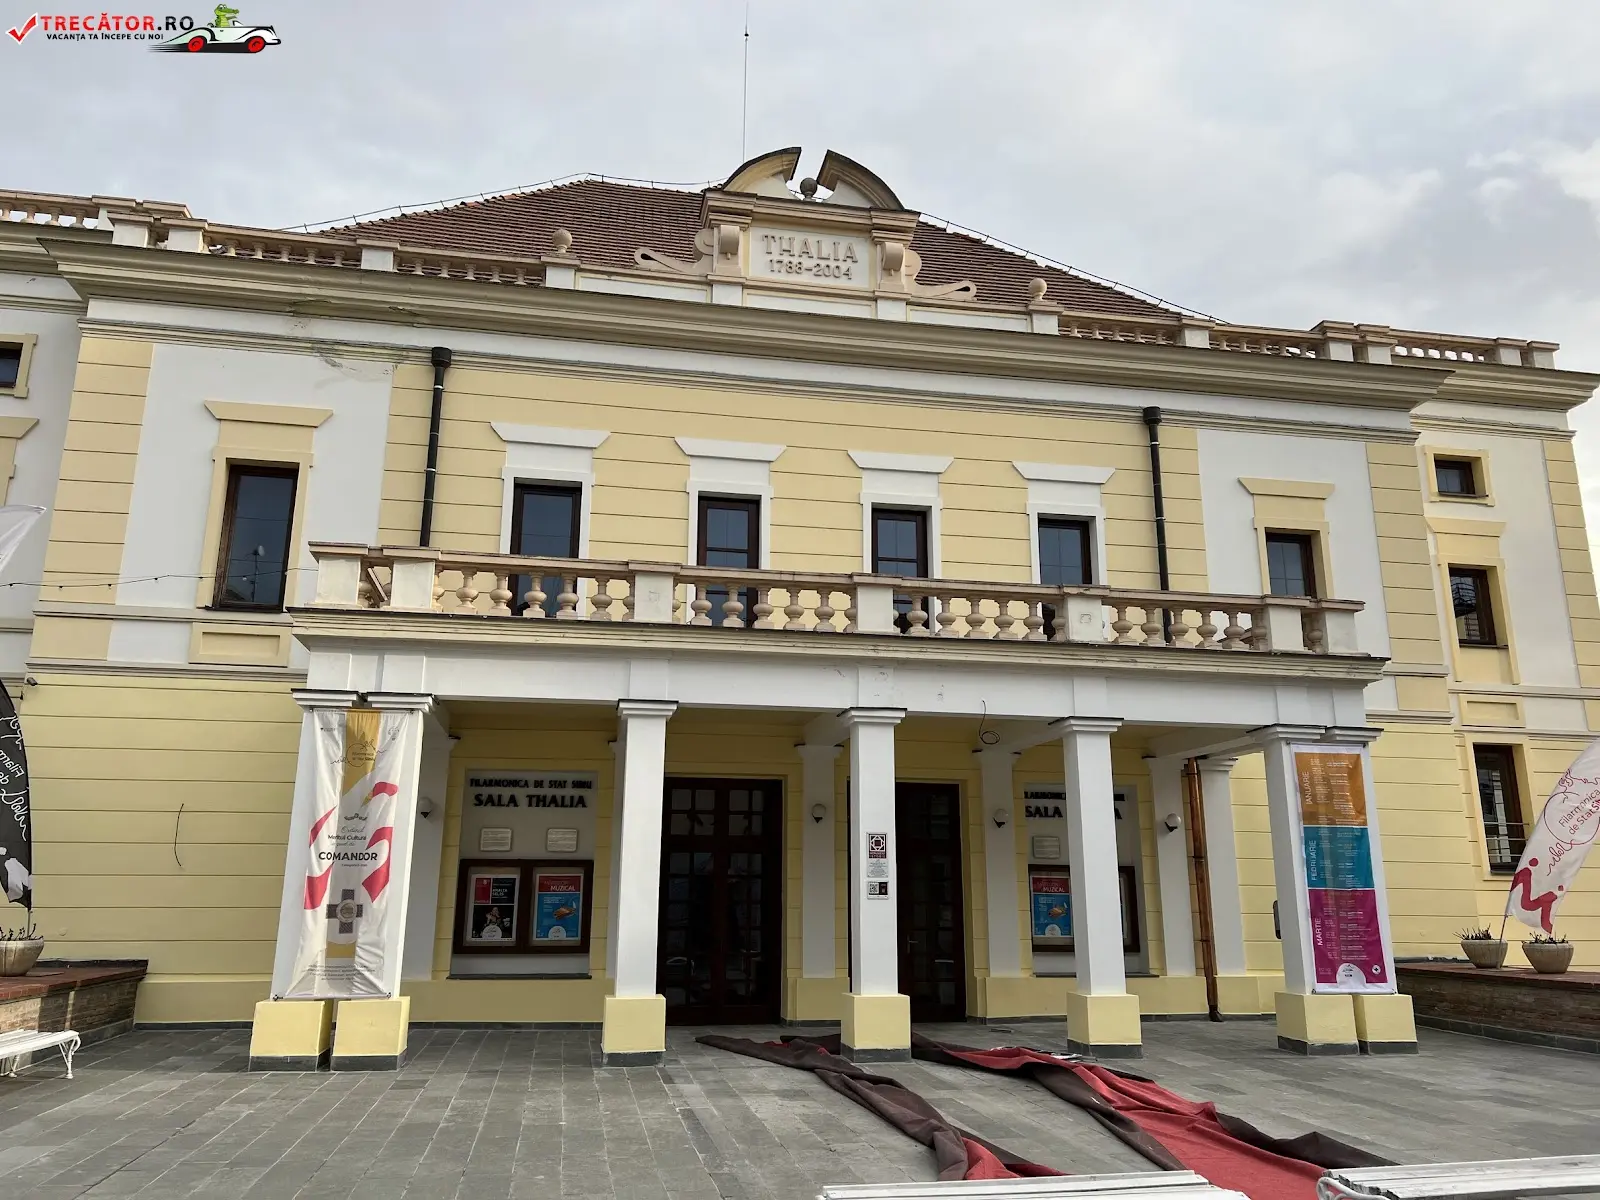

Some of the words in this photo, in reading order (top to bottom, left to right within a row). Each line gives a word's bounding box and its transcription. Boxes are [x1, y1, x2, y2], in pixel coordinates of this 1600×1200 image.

[762, 234, 858, 263] THALIA
[768, 259, 852, 280] 1788-2004
[469, 778, 529, 788] FILARMONICA
[533, 780, 545, 789] DE
[548, 780, 568, 789] STAT
[1302, 770, 1313, 805] IANUARIE
[473, 793, 520, 807] SALA
[525, 794, 588, 808] THALIA
[1025, 805, 1064, 818] SALA
[1568, 824, 1580, 836] de
[1576, 808, 1597, 826] Stat
[318, 851, 378, 861] COMANDOR
[550, 884, 576, 892] MUZICAL
[1314, 917, 1324, 946] MARTIE
